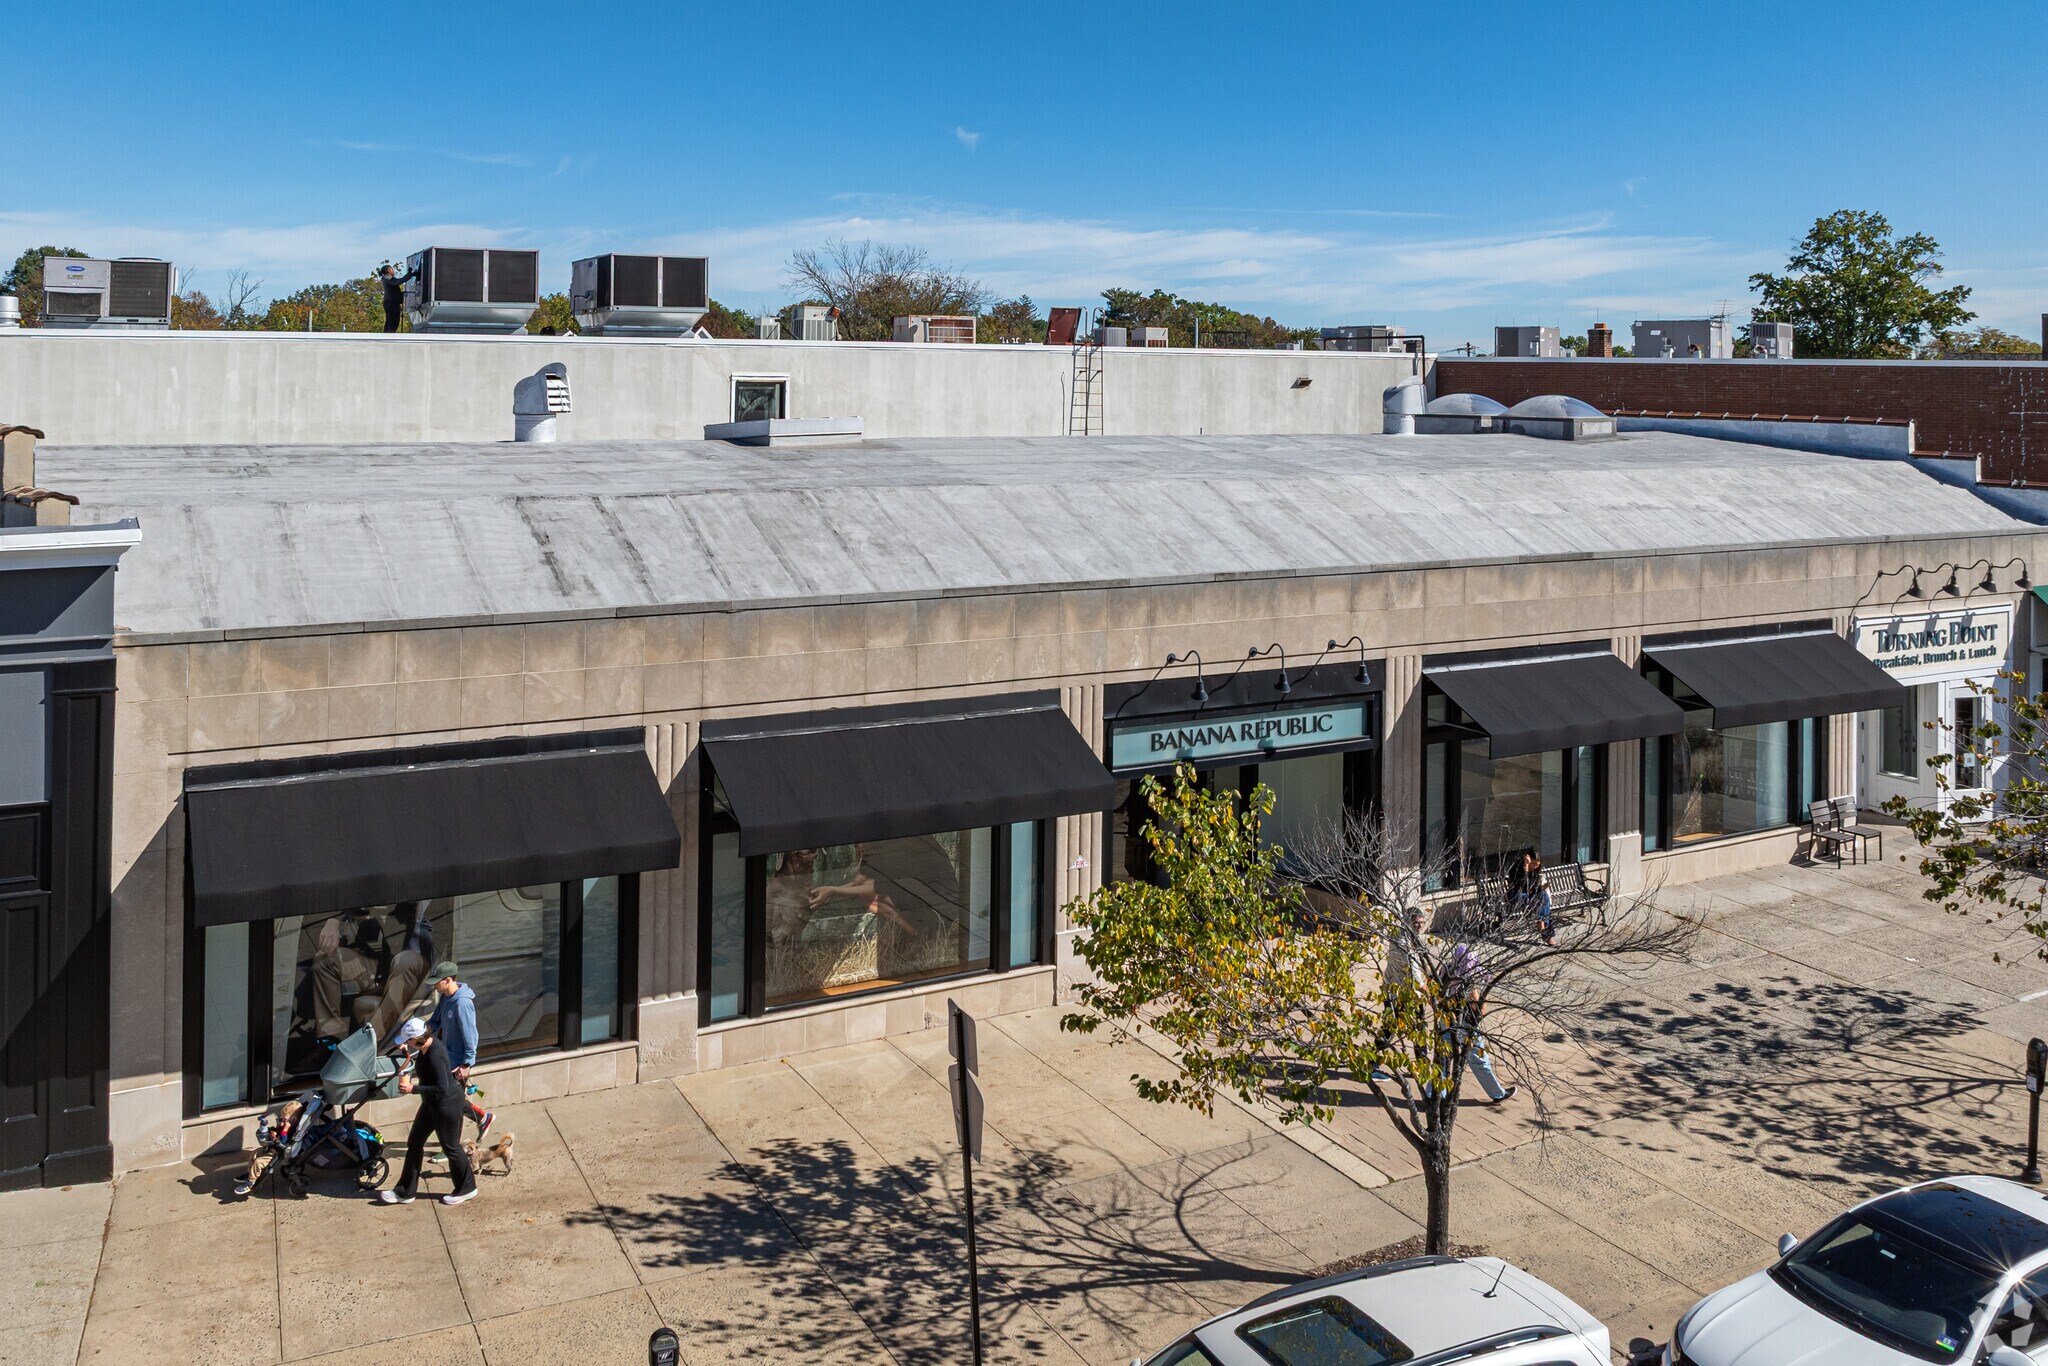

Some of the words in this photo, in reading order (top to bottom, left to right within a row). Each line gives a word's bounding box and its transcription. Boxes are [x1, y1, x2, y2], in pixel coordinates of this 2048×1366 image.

[1872, 629, 1947, 653] TURNING
[1949, 621, 1998, 645] POINT
[1923, 650, 1957, 664] Brunch
[1959, 649, 1966, 660] &
[1968, 645, 1997, 659] Lunch
[1151, 725, 1237, 752] BANANA
[1241, 713, 1333, 741] REPUBLIC
